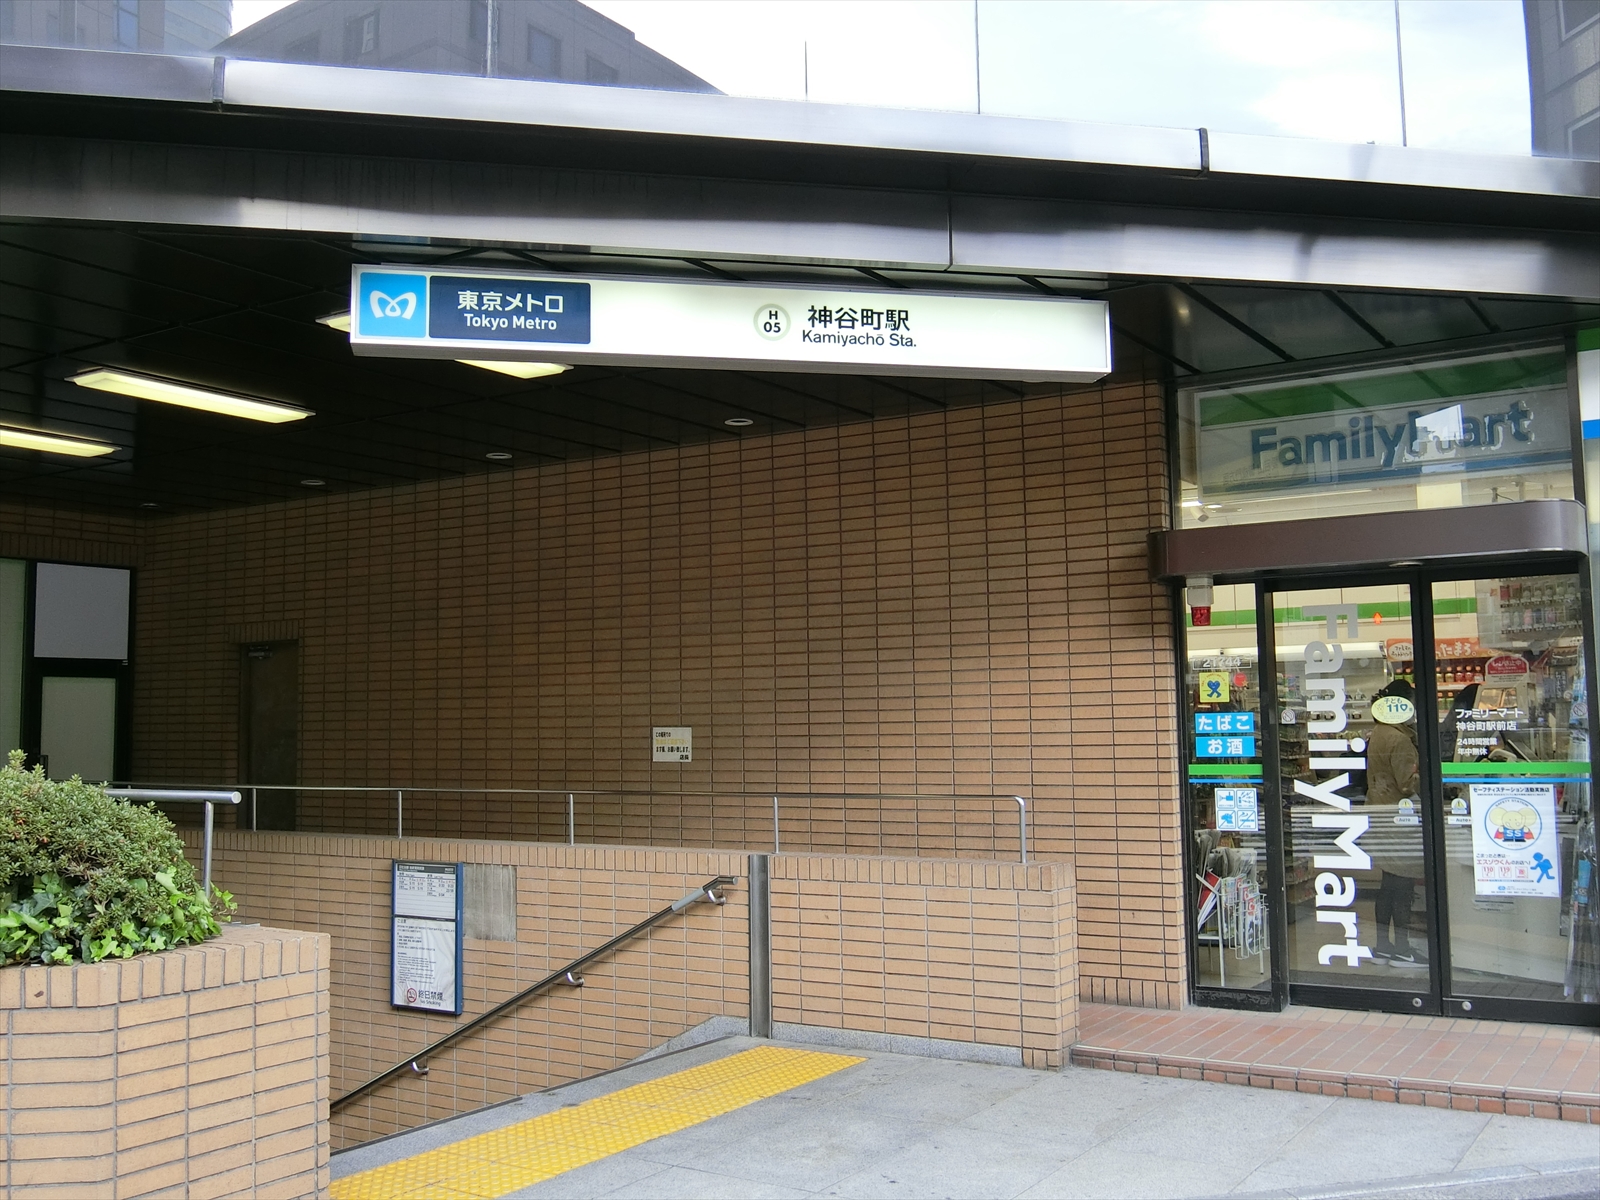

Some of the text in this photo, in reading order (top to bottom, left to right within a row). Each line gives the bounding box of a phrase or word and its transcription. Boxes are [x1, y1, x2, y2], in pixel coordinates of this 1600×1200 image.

[457, 290, 564, 313] 東京メトロ
[464, 313, 557, 331] Tokyo Metro
[768, 310, 778, 320] H
[807, 304, 911, 331] 神谷町駅
[763, 321, 781, 333] 05
[889, 333, 917, 347] Sta.
[1455, 707, 1524, 718] ファミリーマート
[1198, 714, 1250, 731] たばこ
[1456, 721, 1517, 731] 神谷町駅前店
[1207, 739, 1243, 755] お酒
[1294, 603, 1374, 968] FamilyMart
